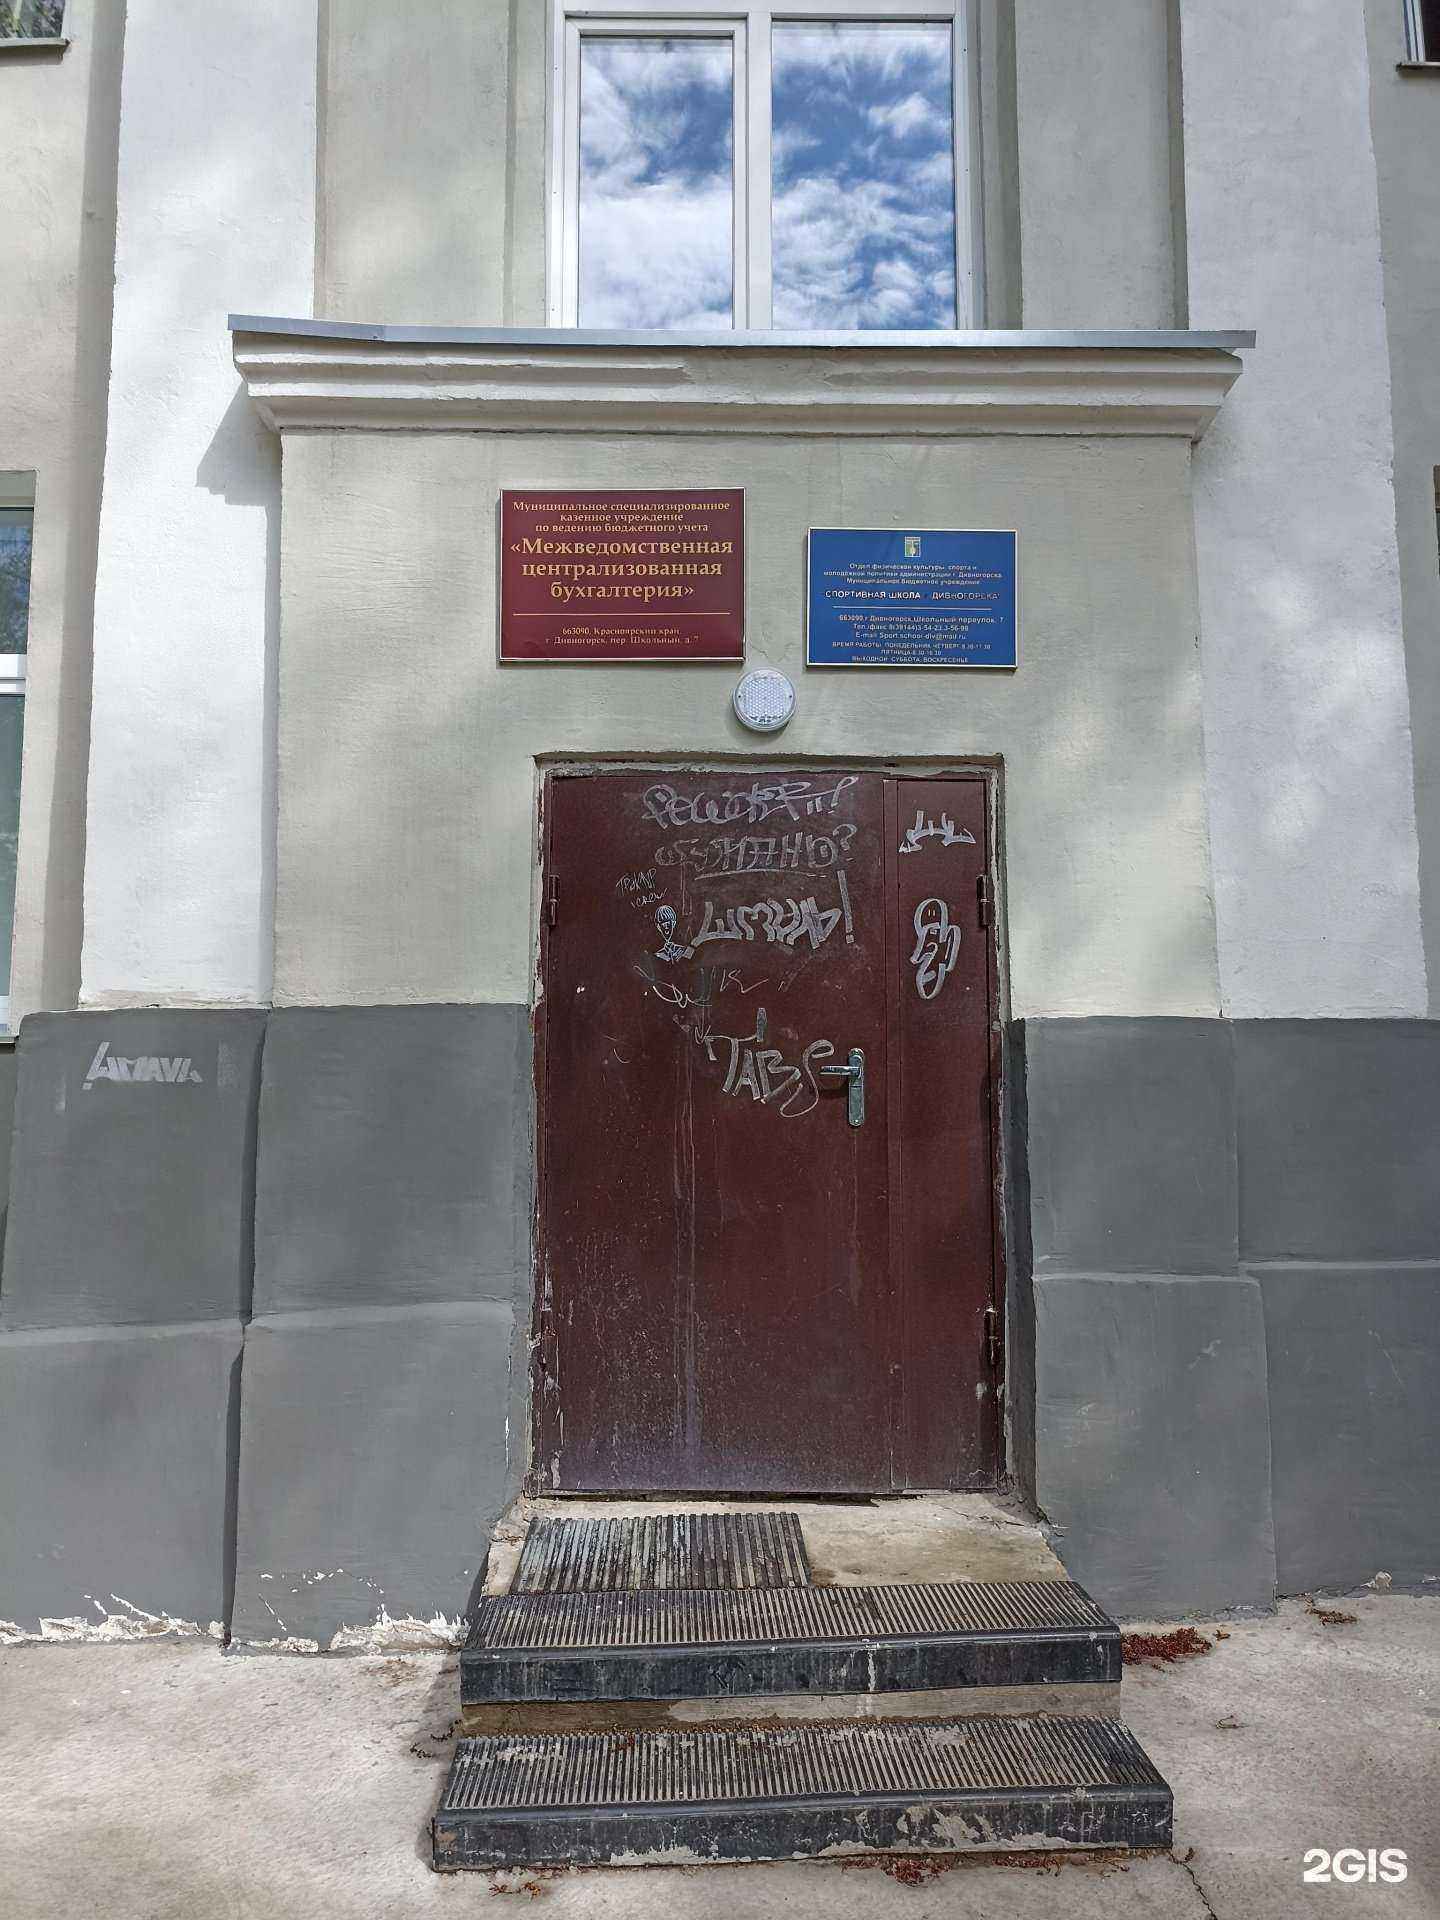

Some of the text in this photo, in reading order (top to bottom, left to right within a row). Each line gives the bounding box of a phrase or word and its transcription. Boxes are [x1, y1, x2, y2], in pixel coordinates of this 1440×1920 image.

[512, 501, 730, 512] Муниципальное специализированное
[560, 514, 684, 524] казенное учреждение
[535, 523, 709, 534] по ведению бюджетного учета
[510, 538, 733, 556] «Межведомственная
[522, 562, 722, 581] централизованная
[550, 581, 694, 603] бухгалтерия»
[888, 590, 921, 600] ШКОЛА
